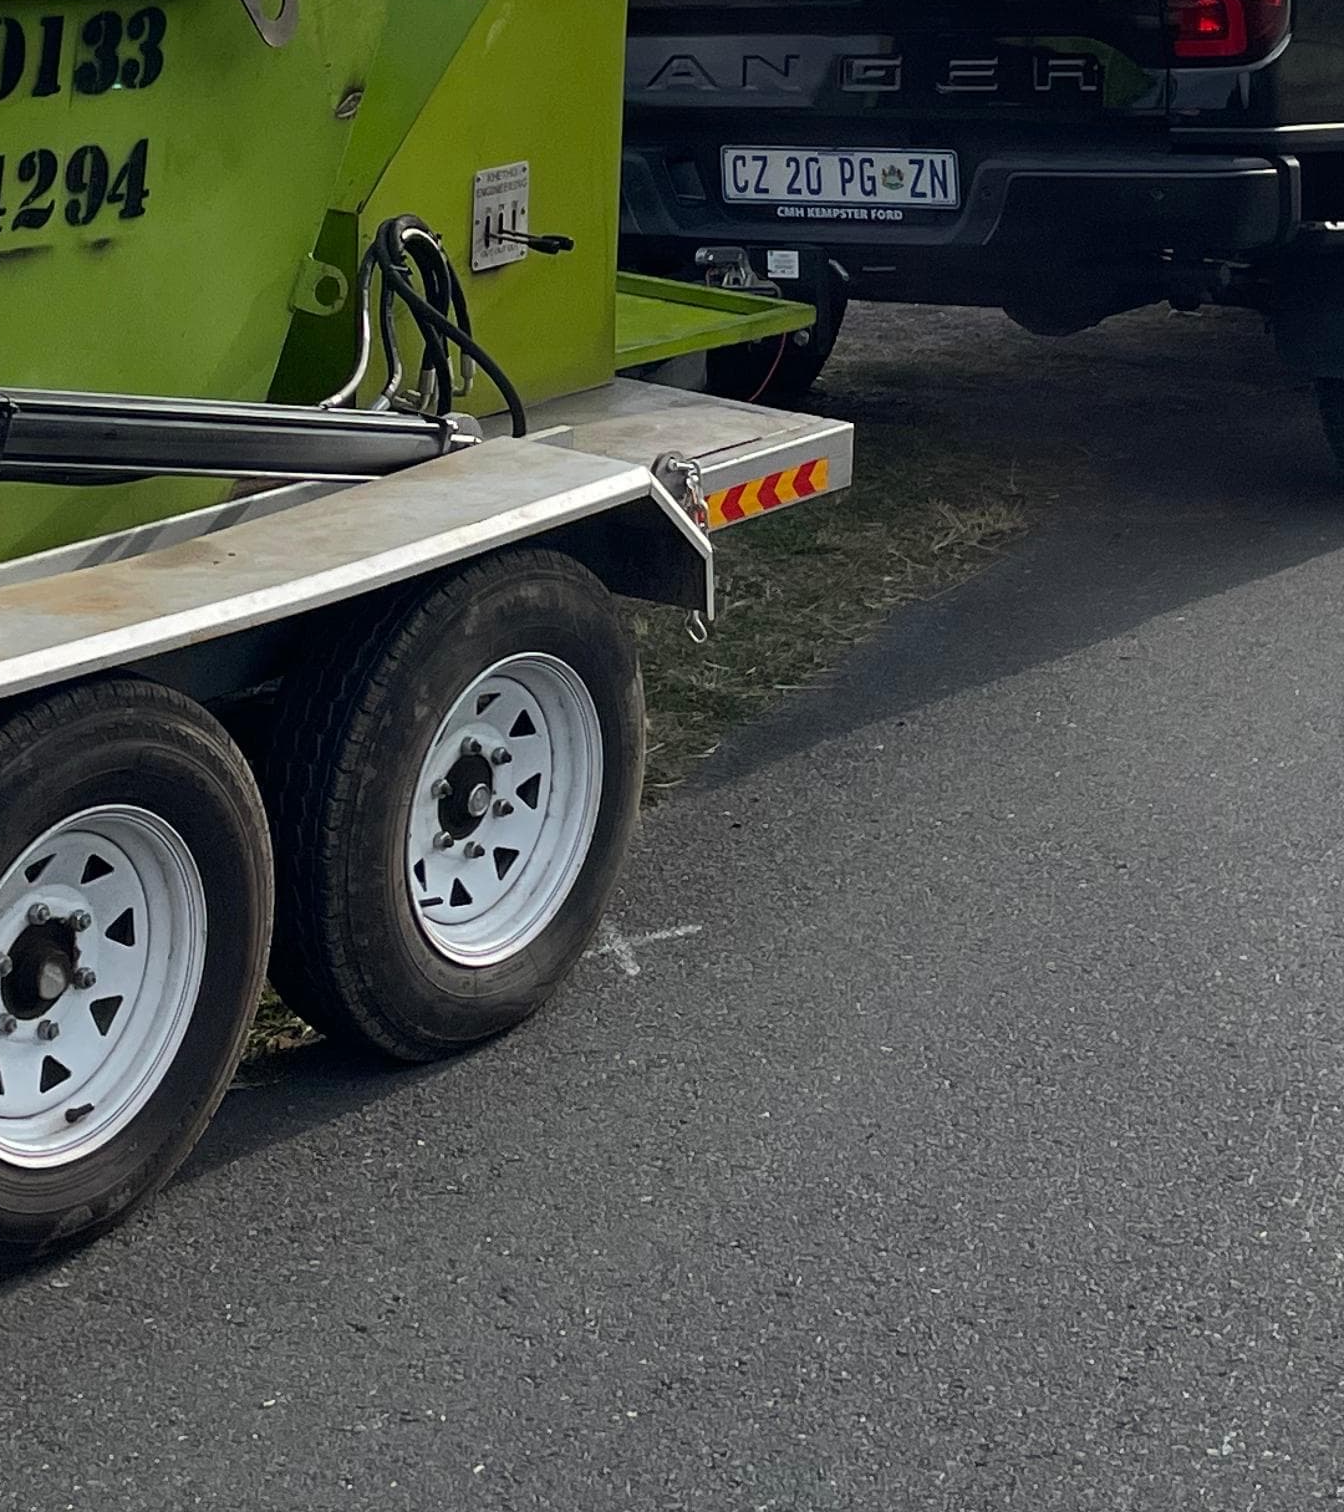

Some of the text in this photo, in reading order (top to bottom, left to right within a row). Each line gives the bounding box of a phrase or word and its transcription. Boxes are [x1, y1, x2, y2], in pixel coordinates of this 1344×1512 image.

[646, 53, 1099, 93] ANGER
[731, 154, 949, 199] CZ 20 PG ZN
[776, 205, 904, 221] CMH KEMPSTER FORD
